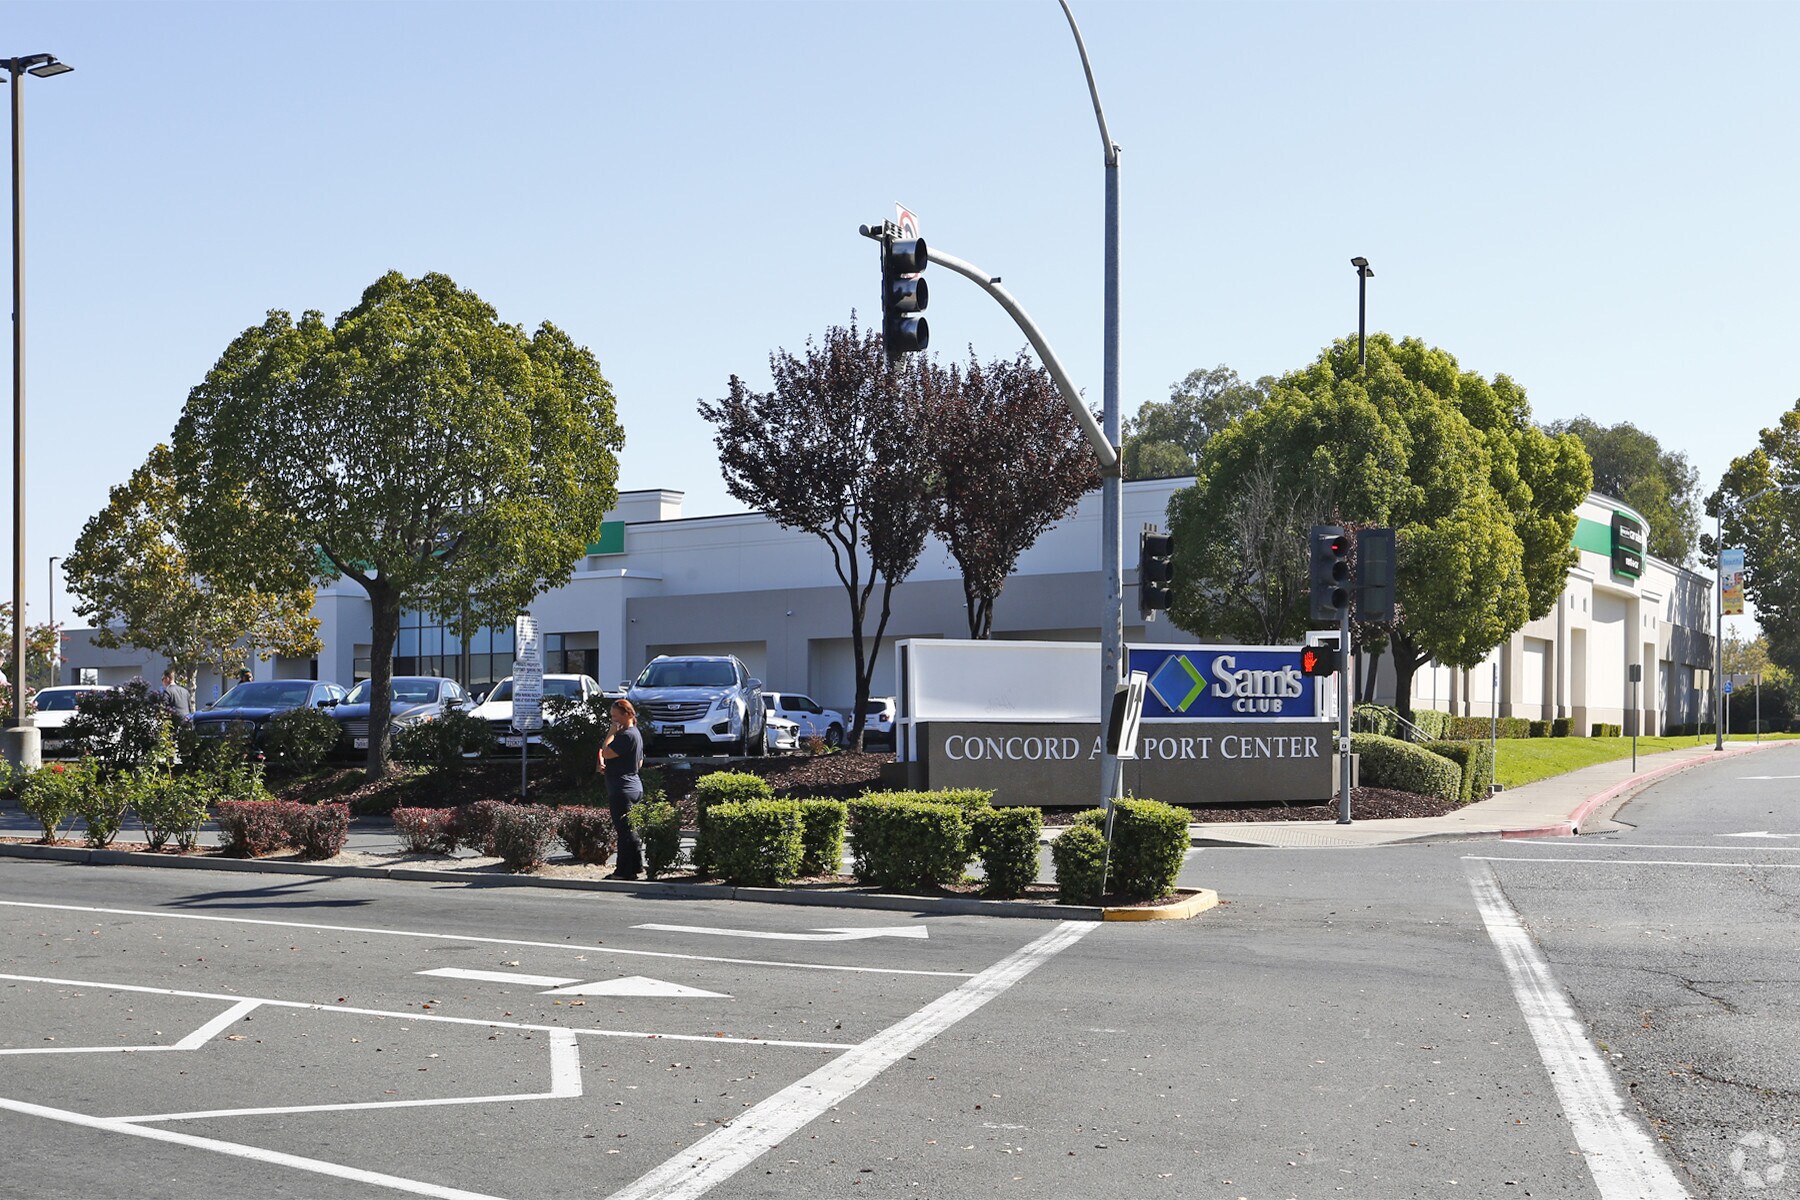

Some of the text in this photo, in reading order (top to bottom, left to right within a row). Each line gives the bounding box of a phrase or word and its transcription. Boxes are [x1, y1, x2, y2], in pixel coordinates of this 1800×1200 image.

[1211, 655, 1303, 698] Sam's
[1232, 698, 1283, 713] CLUB
[945, 735, 1319, 760] CONCORD APORT CENTER
